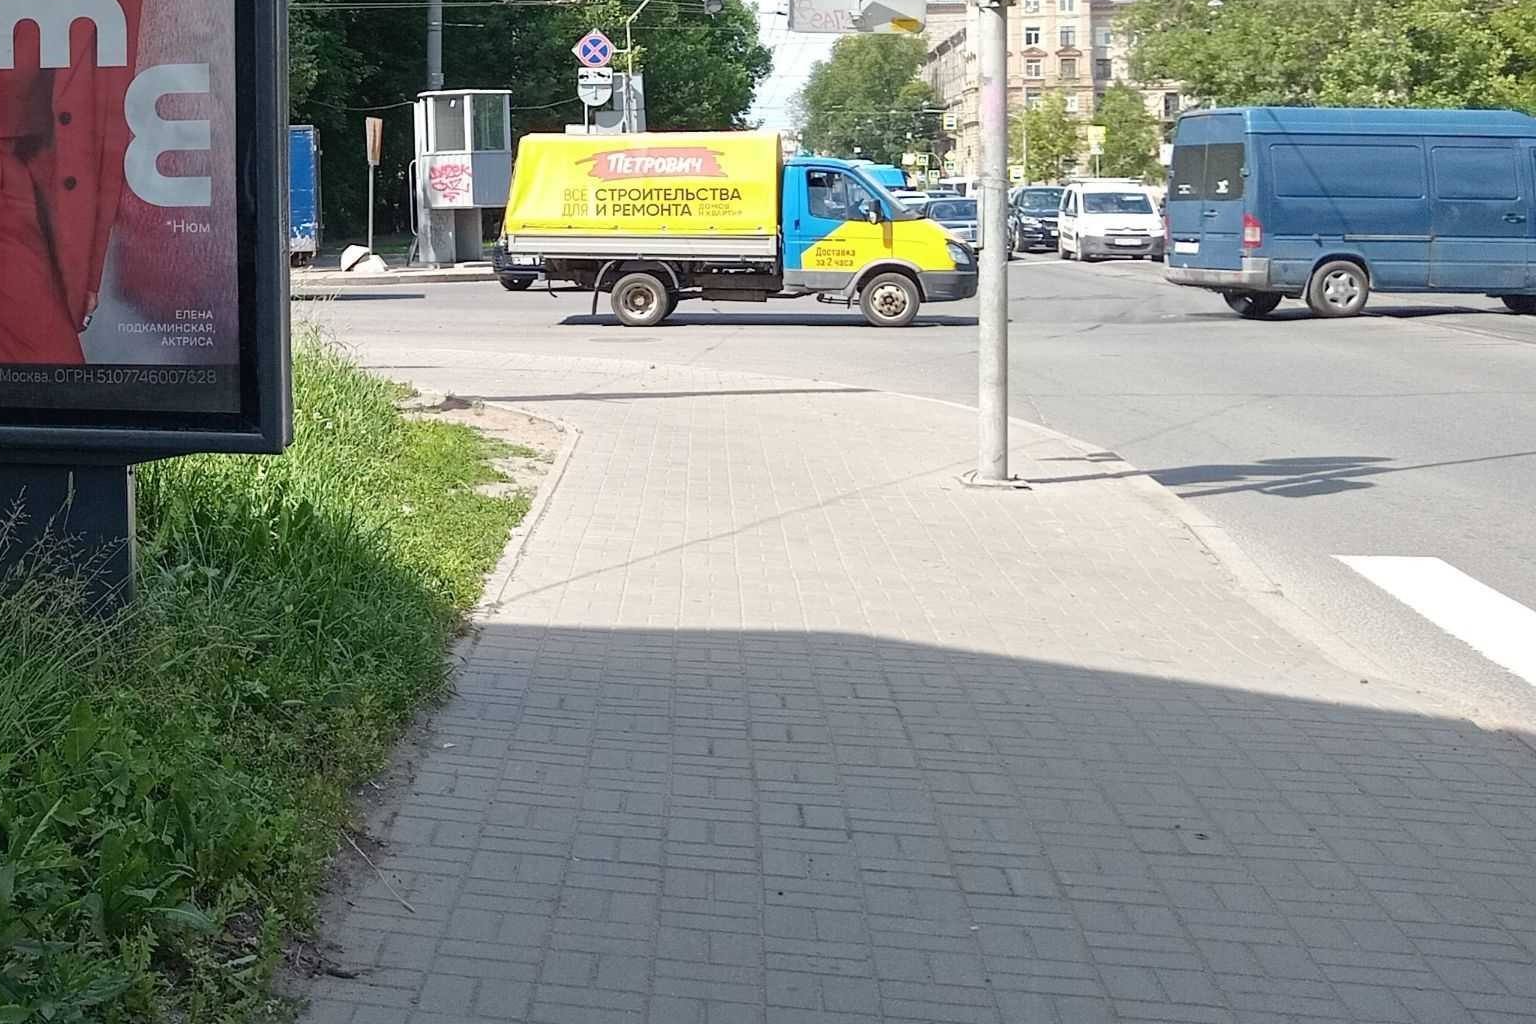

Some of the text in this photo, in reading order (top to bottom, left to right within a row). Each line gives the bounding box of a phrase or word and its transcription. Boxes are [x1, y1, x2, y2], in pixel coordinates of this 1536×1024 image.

[563, 187, 743, 202] ВСЕ СТРОИТЕЛЬСТВА
[561, 202, 693, 217] ДЛЯ И РЕМОНТА
[815, 247, 856, 257] Доставка
[826, 257, 832, 266] 2
[175, 309, 214, 320] ЕЛЕНА
[117, 322, 216, 334] ПОДКАМИНСКАЯ,
[160, 336, 214, 347] АКТРИСА
[54, 368, 95, 384] ОГРН
